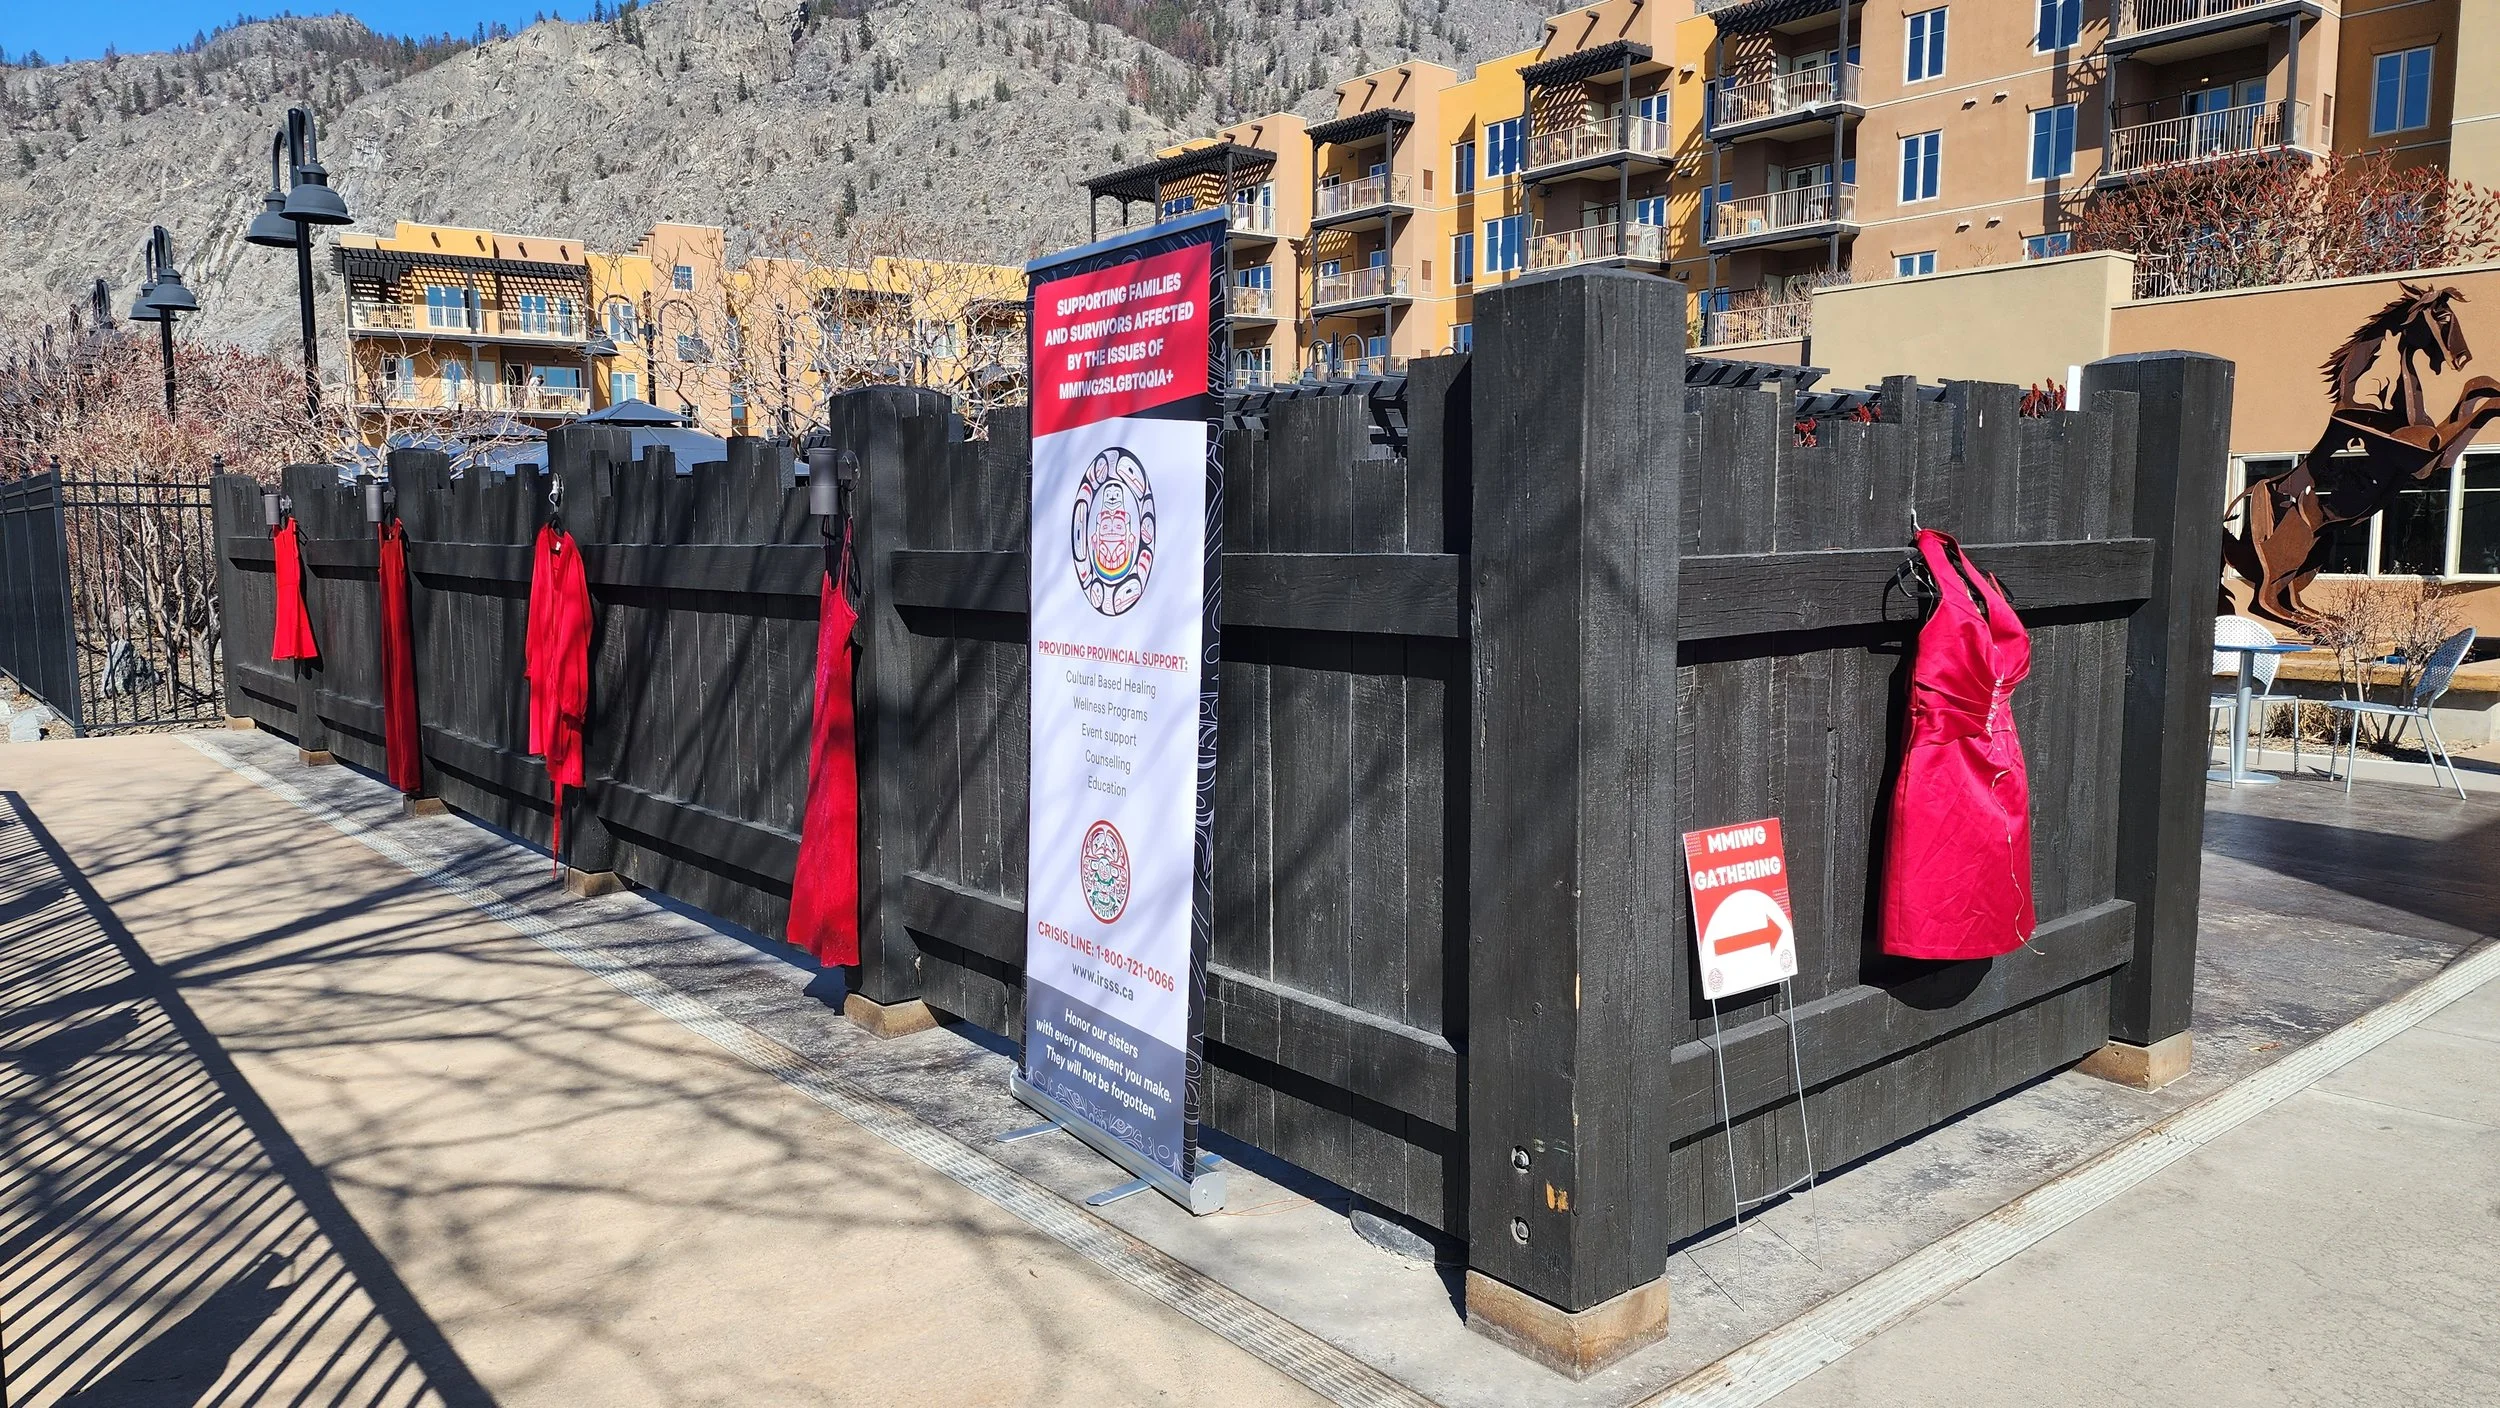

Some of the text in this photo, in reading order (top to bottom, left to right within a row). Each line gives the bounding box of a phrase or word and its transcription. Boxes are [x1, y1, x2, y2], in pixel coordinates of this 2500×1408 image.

[1057, 272, 1181, 316] SUPPORTING FAMILIES
[1045, 301, 1194, 346] AND SURVIVORS AFFECTED
[1067, 338, 1164, 371] BY THE ISSUES OF
[1059, 369, 1174, 400] MMIWG2SLGBTQQIA+
[1038, 640, 1188, 671] PROVIDING PROVINCIAL SUPPORT:
[1066, 670, 1156, 699] Cultural Based Healing
[1073, 696, 1148, 722] Wellness Programs
[1082, 723, 1137, 747] Event support
[1085, 749, 1131, 775] Counselling
[1088, 776, 1127, 798] Education
[1707, 825, 1766, 854] MMIWG
[1694, 856, 1781, 891] GATHERING
[1038, 920, 1175, 992] CRISIS LINE: 1-800-721-0066
[1072, 961, 1134, 1002] www.irsss.ca
[1065, 1008, 1139, 1059] Honor our sisters
[1036, 1018, 1172, 1104] with every movement you make.
[1046, 1044, 1157, 1121] They will not be forgotten.
